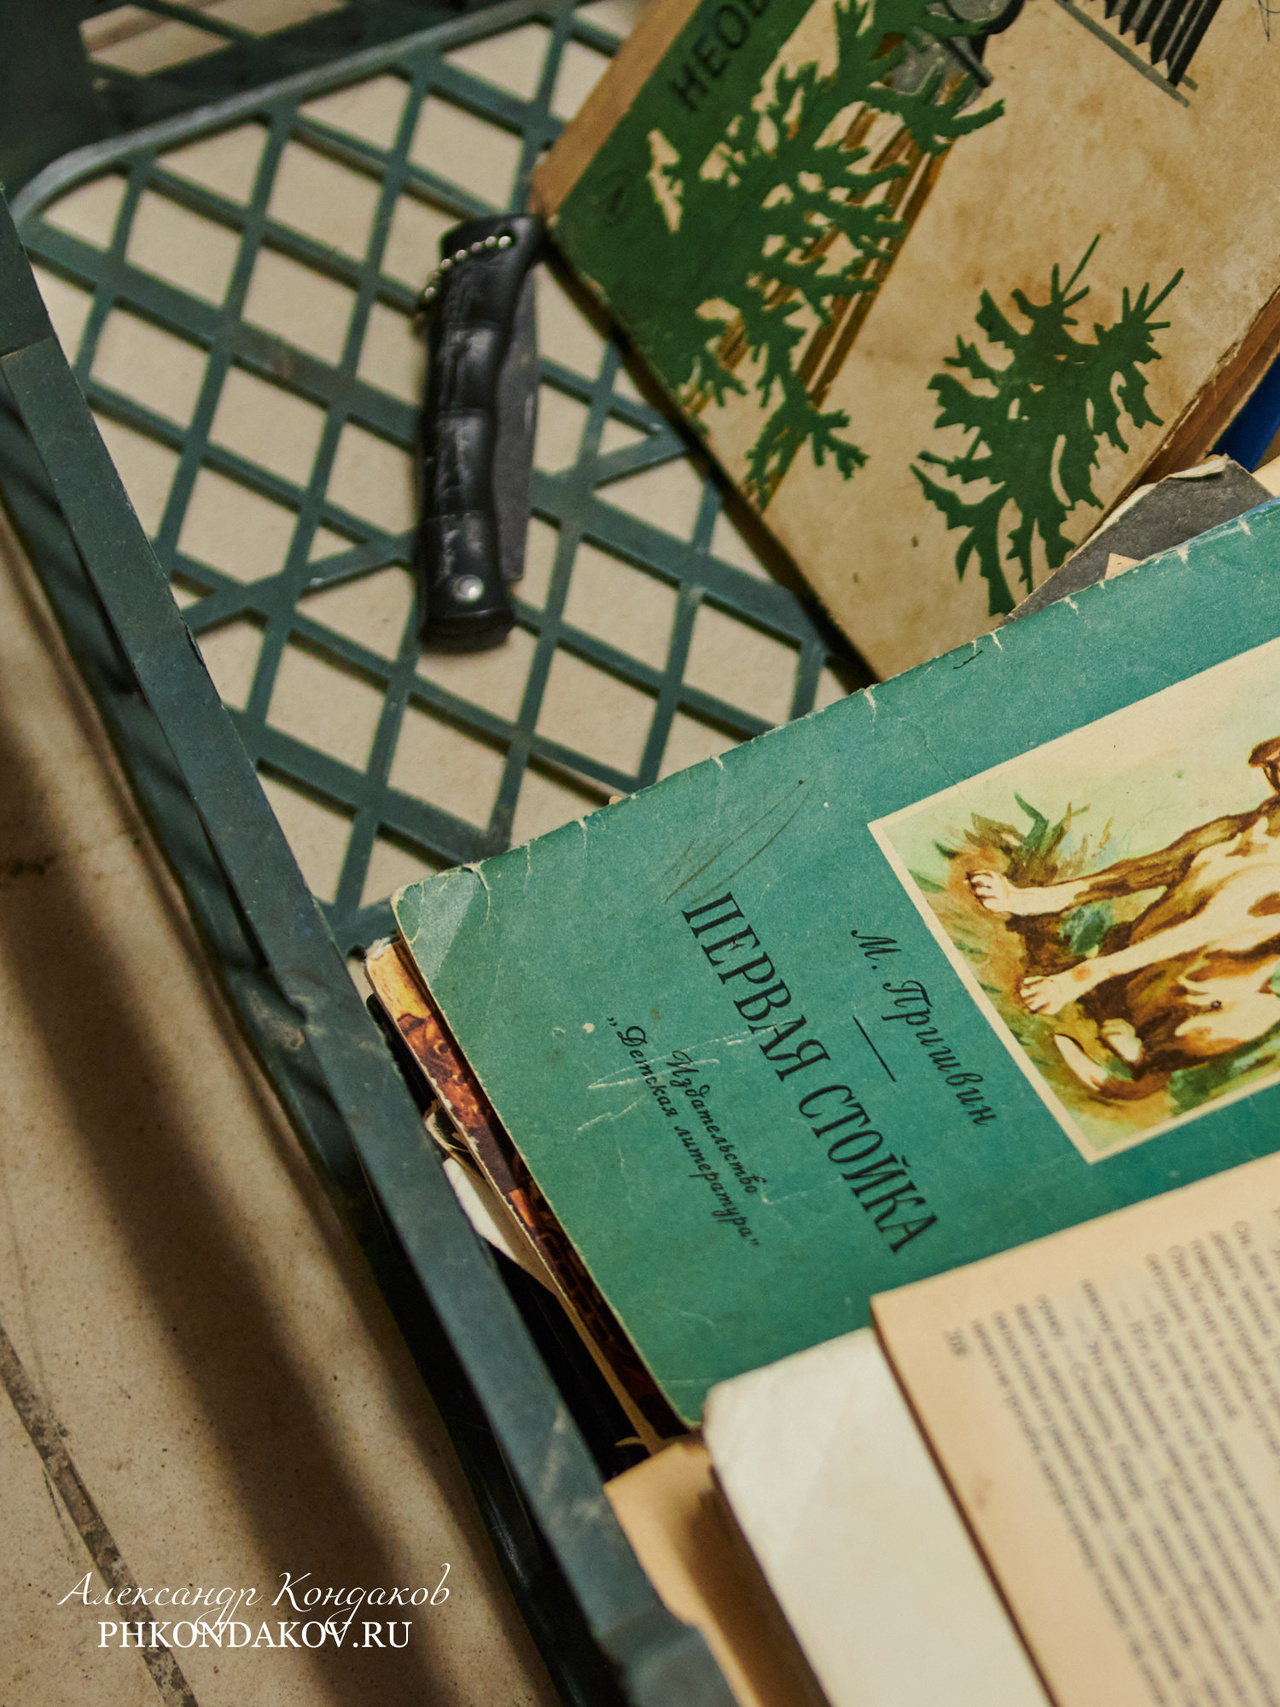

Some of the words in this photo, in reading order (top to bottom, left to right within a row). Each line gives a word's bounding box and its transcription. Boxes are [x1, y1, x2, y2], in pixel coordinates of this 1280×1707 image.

[665, 1049, 768, 1195] Издательство
[681, 891, 832, 1082] ПЕРВАЯ
[799, 1084, 938, 1254] СТОЙКА
[850, 929, 902, 970] М.
[881, 979, 998, 1126] Пришвин
